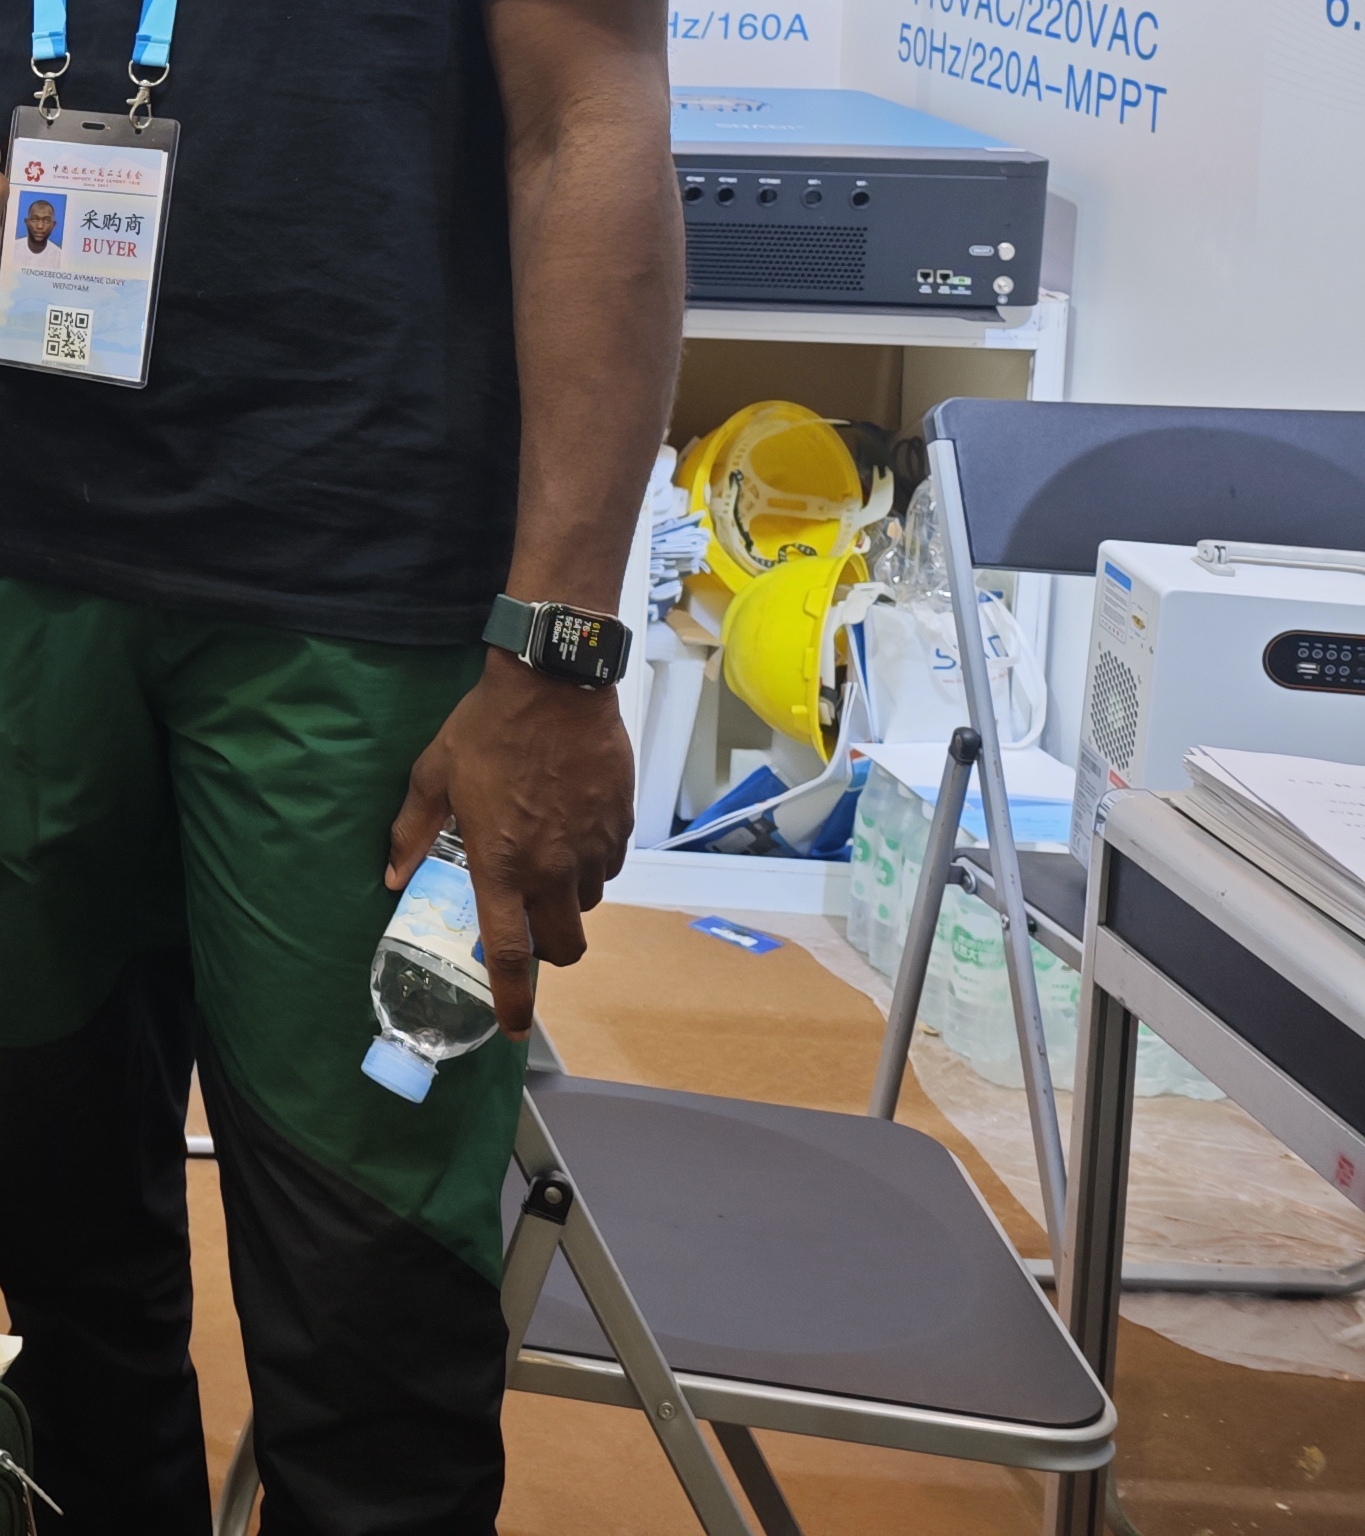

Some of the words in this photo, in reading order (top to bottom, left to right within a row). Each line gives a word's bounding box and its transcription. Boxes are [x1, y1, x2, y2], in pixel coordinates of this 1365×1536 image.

[81, 210, 144, 235] 采购商
[82, 238, 137, 258] BUYER
